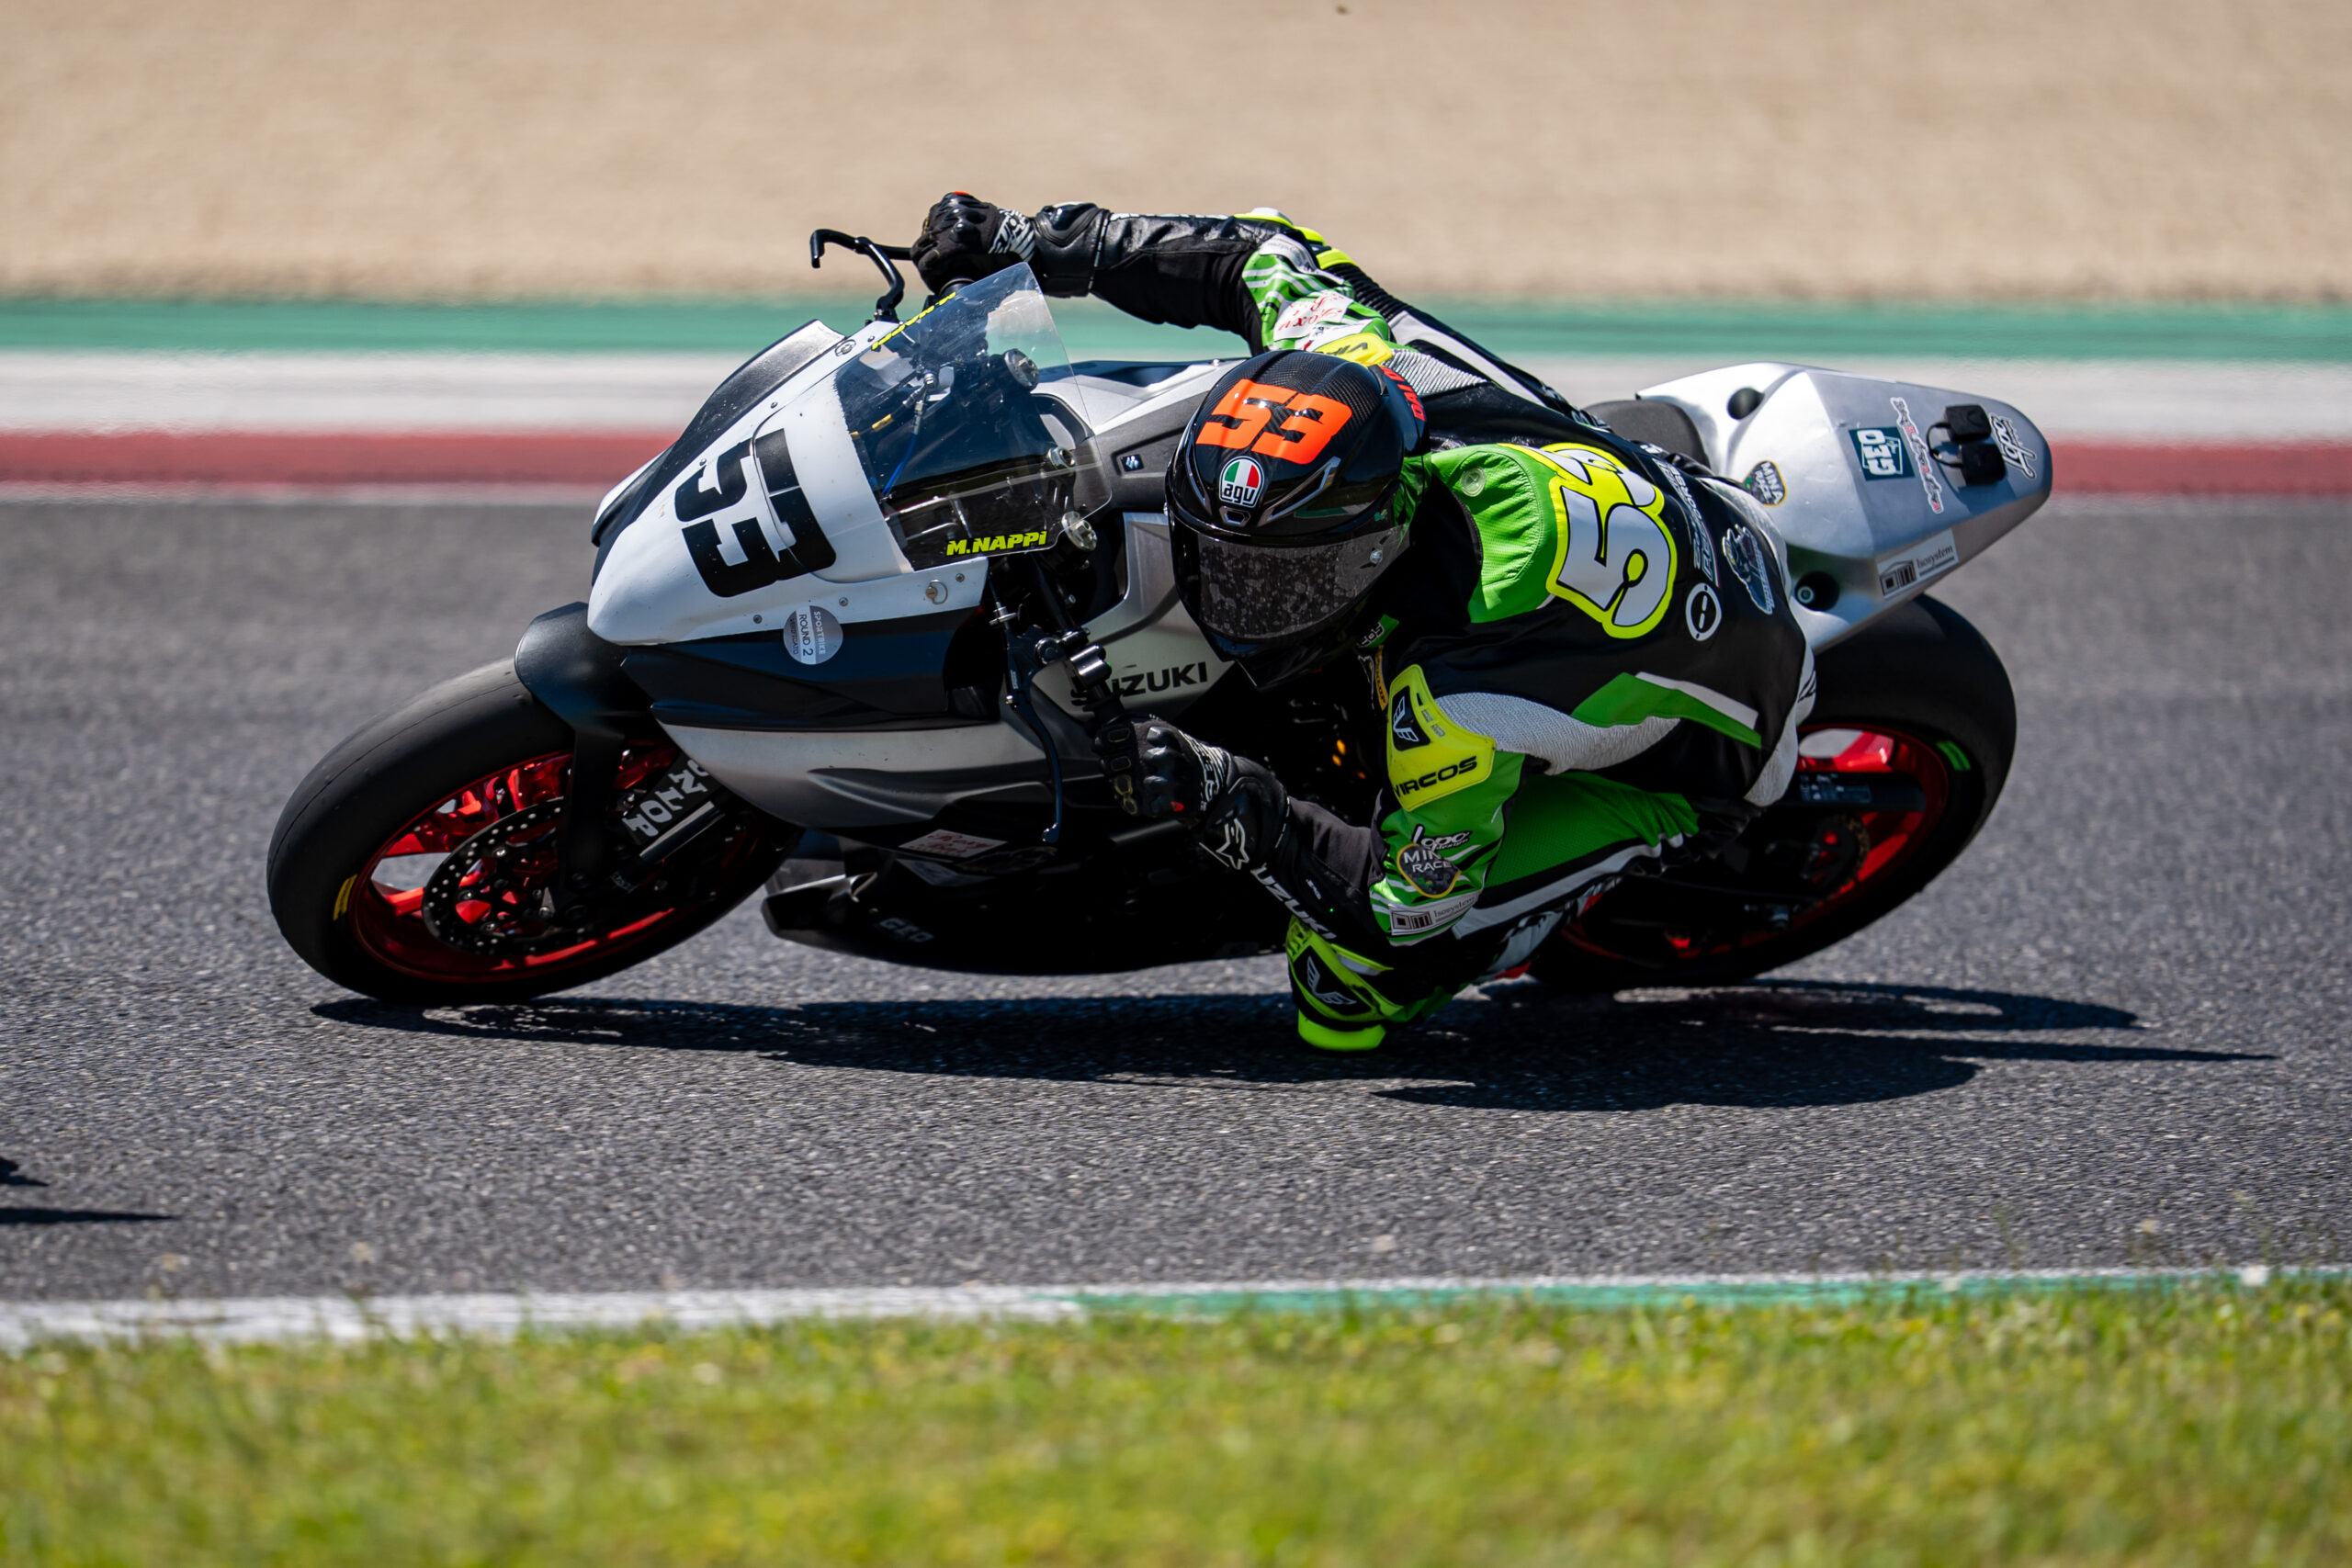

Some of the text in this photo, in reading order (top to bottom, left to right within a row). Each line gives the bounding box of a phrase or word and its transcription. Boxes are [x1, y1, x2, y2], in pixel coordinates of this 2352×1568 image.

[1196, 378, 1352, 465] 53
[1858, 429, 1898, 477] GEO
[1222, 482, 1257, 506] agv
[1760, 461, 1784, 505] MINA
[674, 428, 836, 598] 53
[945, 530, 1048, 557] M.NAPPI
[798, 614, 814, 657] ROUND 2
[813, 610, 826, 655] SPORTBIKE
